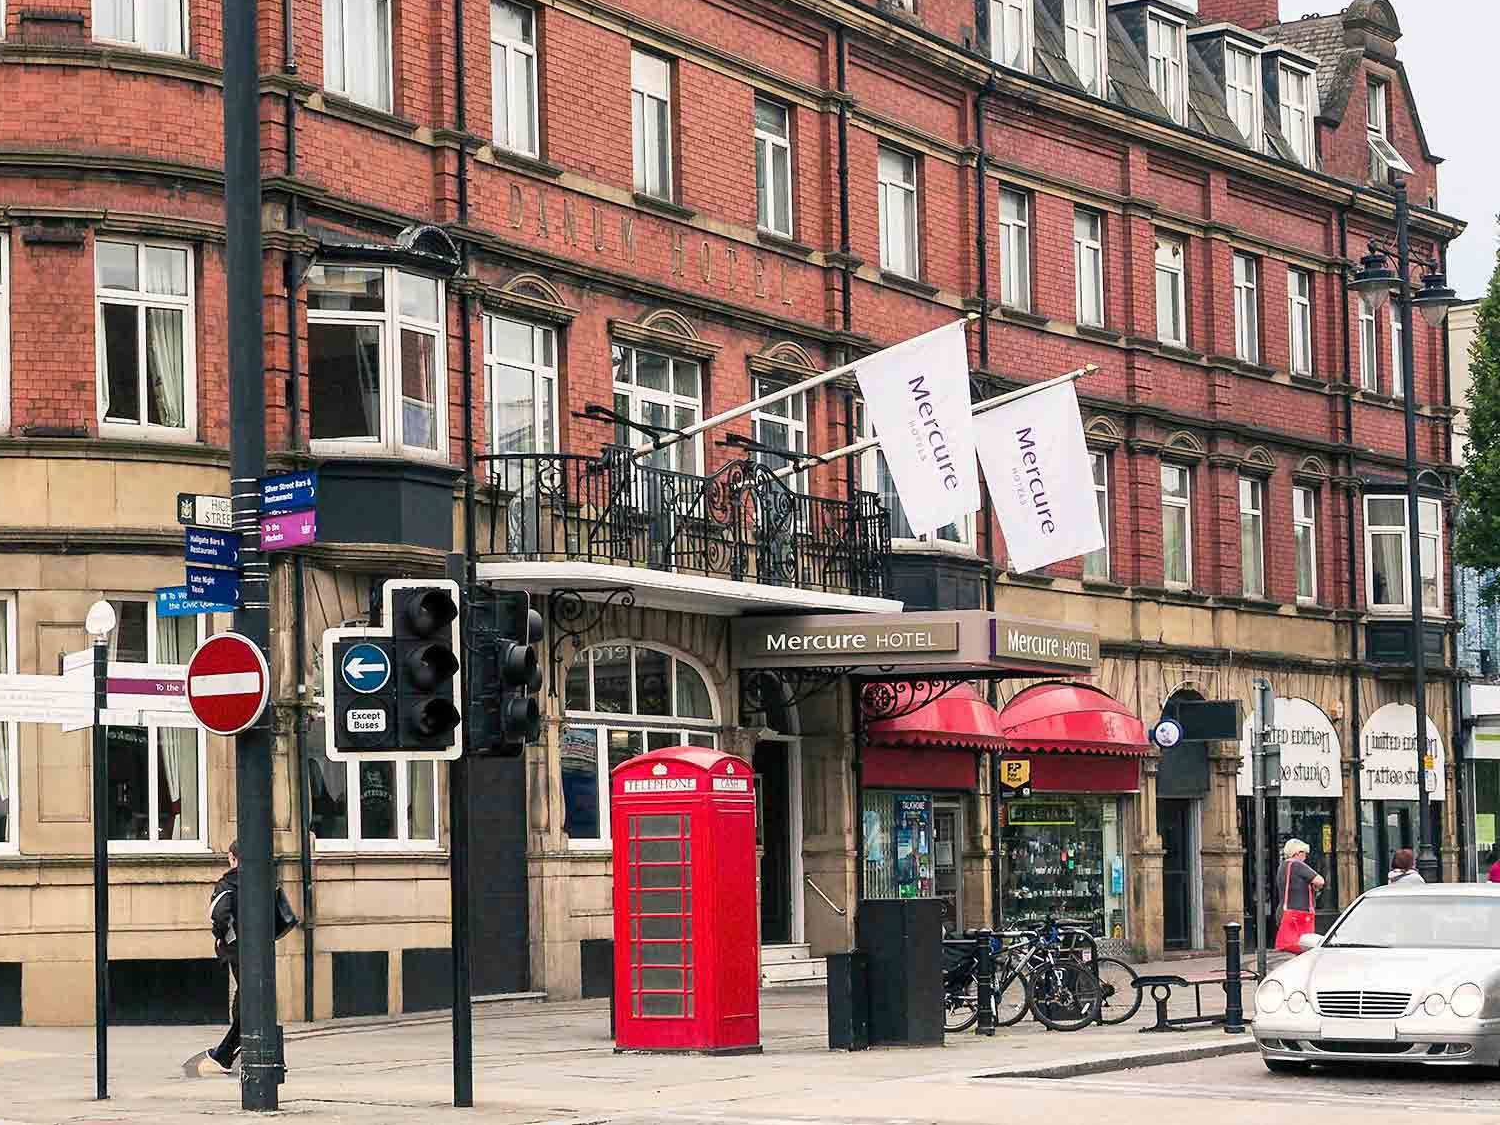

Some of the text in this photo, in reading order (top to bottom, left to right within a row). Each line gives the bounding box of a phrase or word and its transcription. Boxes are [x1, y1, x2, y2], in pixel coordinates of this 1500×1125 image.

[508, 183, 792, 306] DANUM HOTEL
[908, 375, 958, 490] Mercure
[279, 482, 294, 490] Street
[1015, 427, 1055, 535] Mercure
[205, 511, 232, 525] STREE
[766, 632, 937, 651] Mercure HOTEL
[1007, 628, 1093, 660] Mercure HOTEL
[156, 683, 164, 691] To
[166, 683, 180, 692] the
[352, 712, 380, 720] Except
[628, 778, 693, 790] TELEPHONE
